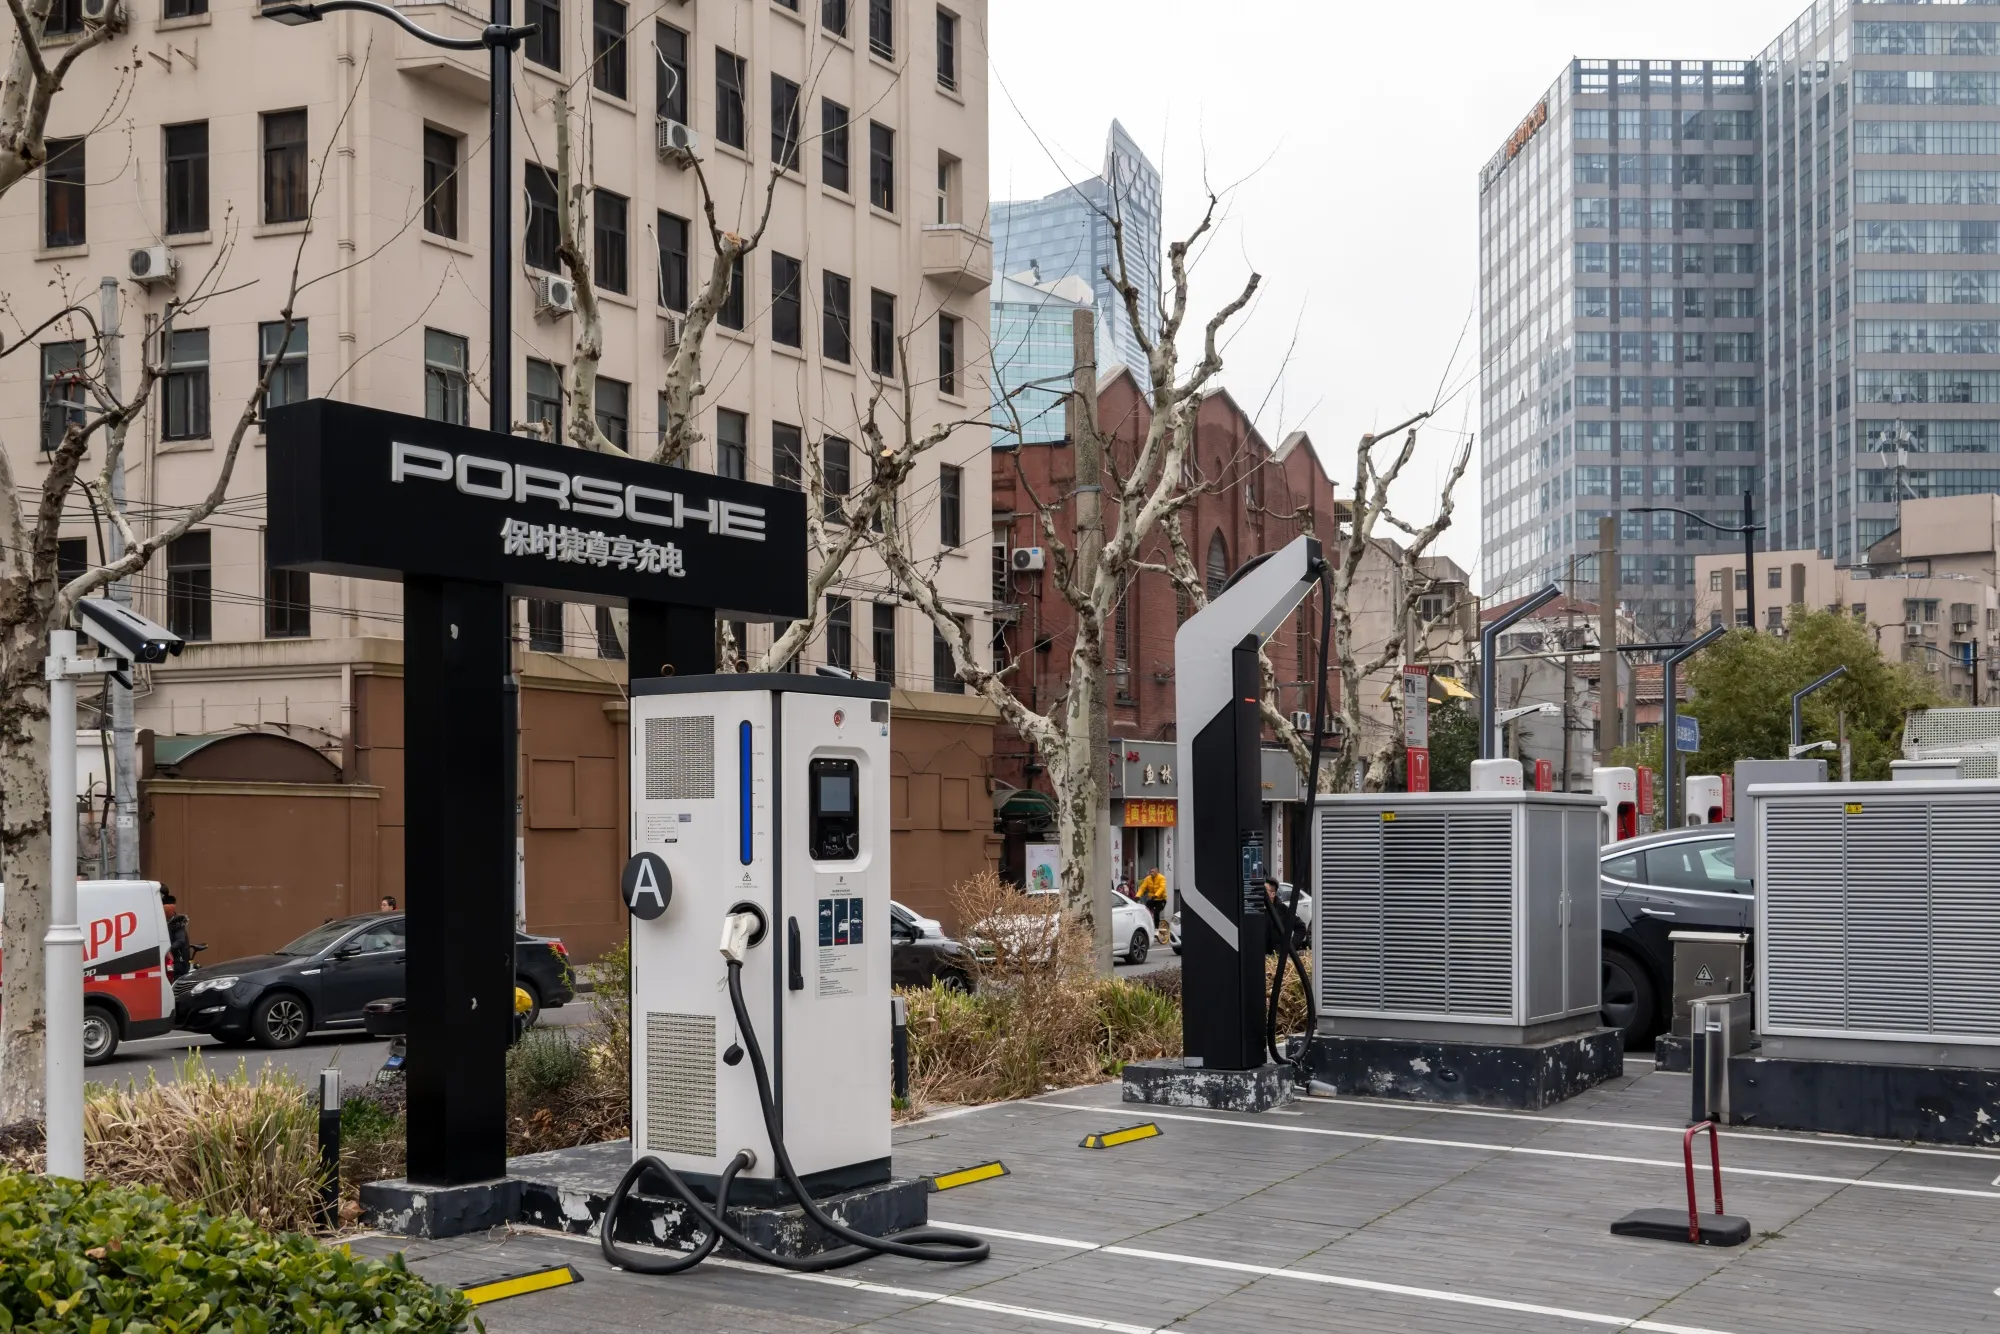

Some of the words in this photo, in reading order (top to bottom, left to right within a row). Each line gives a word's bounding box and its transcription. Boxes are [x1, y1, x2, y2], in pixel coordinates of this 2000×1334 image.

[391, 441, 766, 542] PORSCHE
[500, 517, 686, 578] 保时捷尊享充电
[630, 858, 665, 907] A
